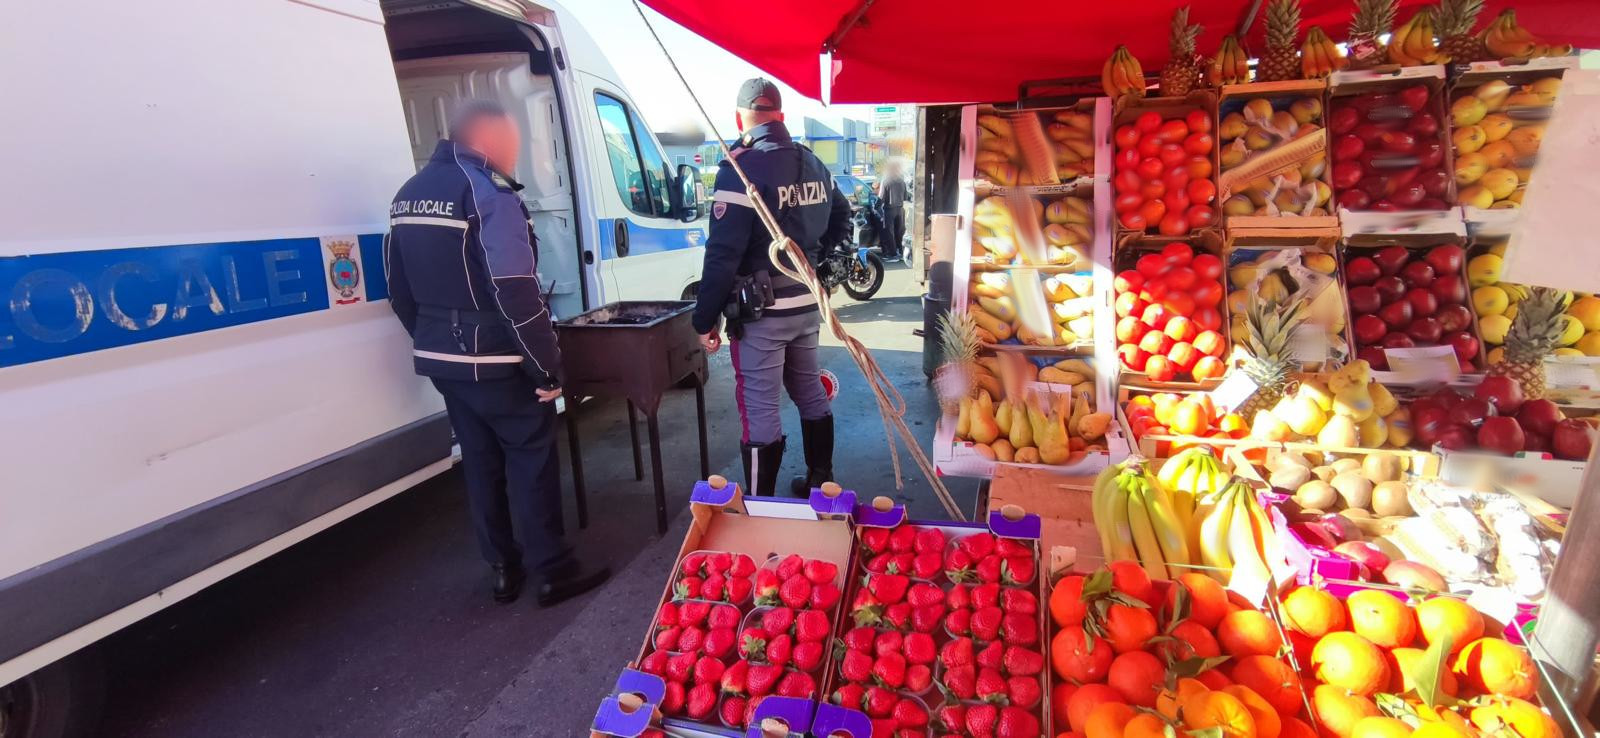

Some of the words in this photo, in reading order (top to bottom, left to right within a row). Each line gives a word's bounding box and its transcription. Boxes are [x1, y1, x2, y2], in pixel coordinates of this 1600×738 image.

[777, 181, 828, 210] POLIZIA
[390, 201, 410, 215] OLIZIA
[413, 200, 454, 216] LOCALE
